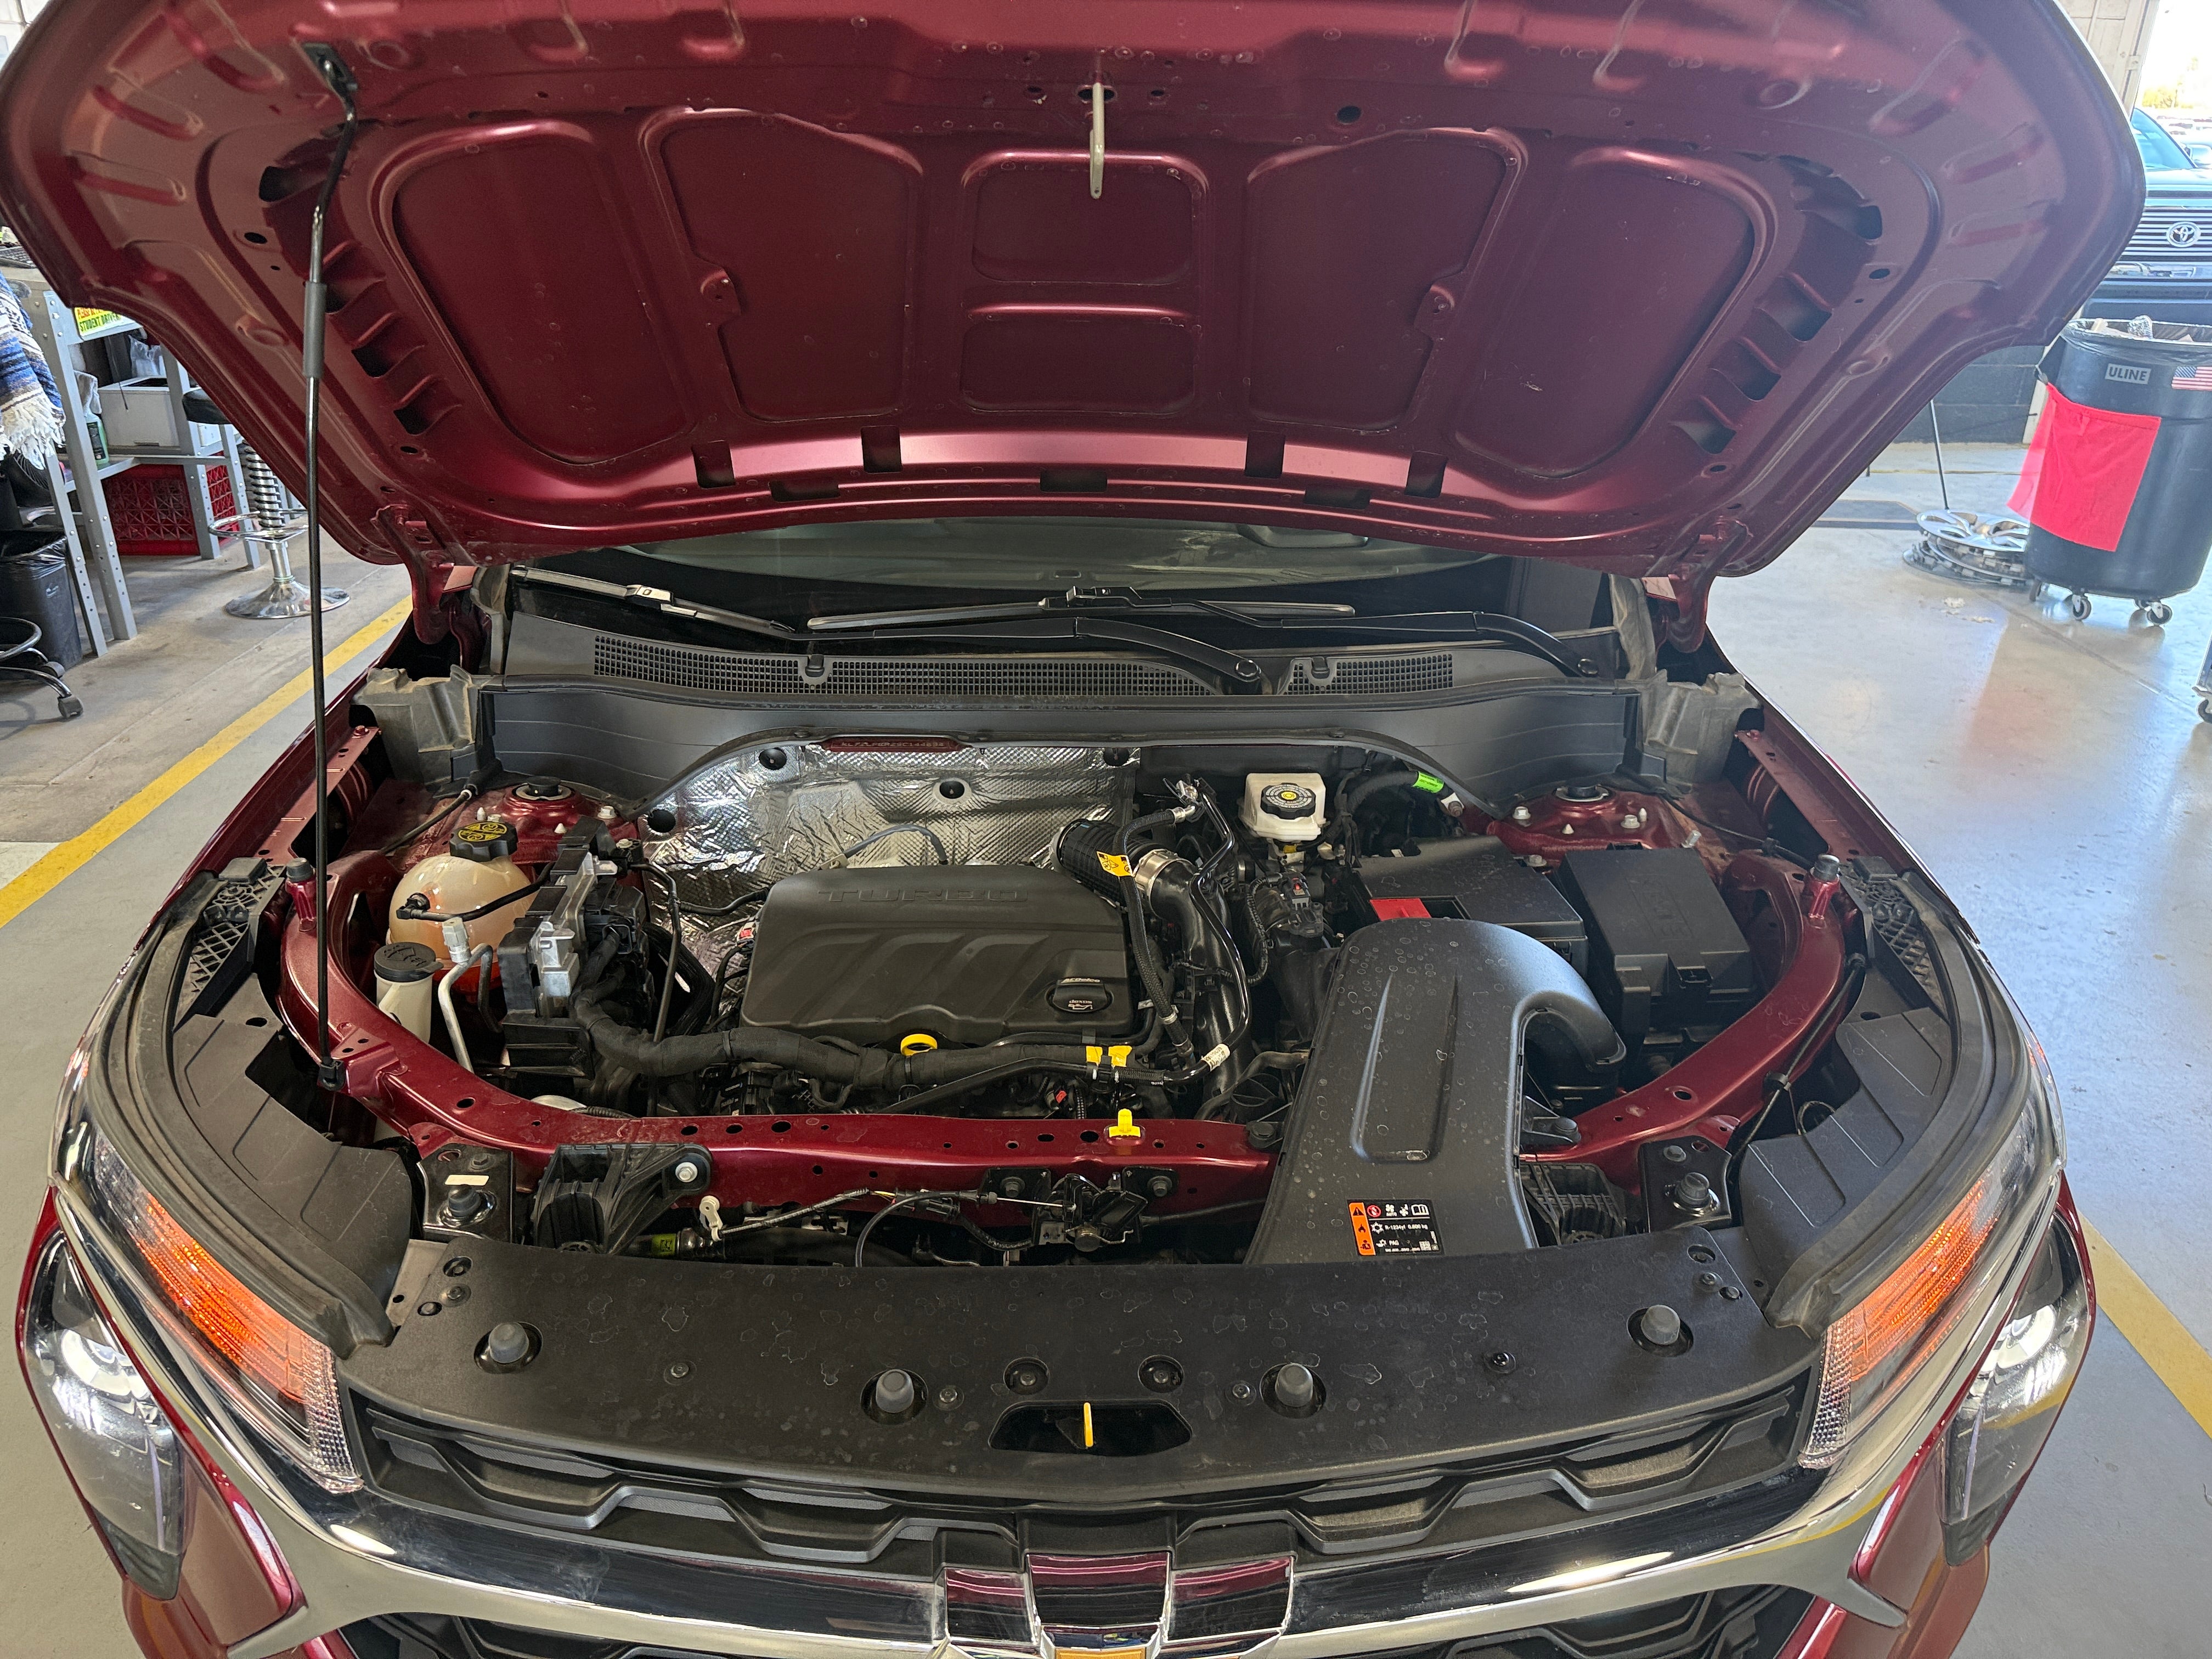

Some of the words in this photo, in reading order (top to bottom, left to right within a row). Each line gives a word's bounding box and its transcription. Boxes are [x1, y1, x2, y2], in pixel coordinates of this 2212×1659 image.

[80, 317, 100, 331] STUDENT
[2108, 366, 2147, 381] ULINE
[818, 889, 1028, 902] TURBO
